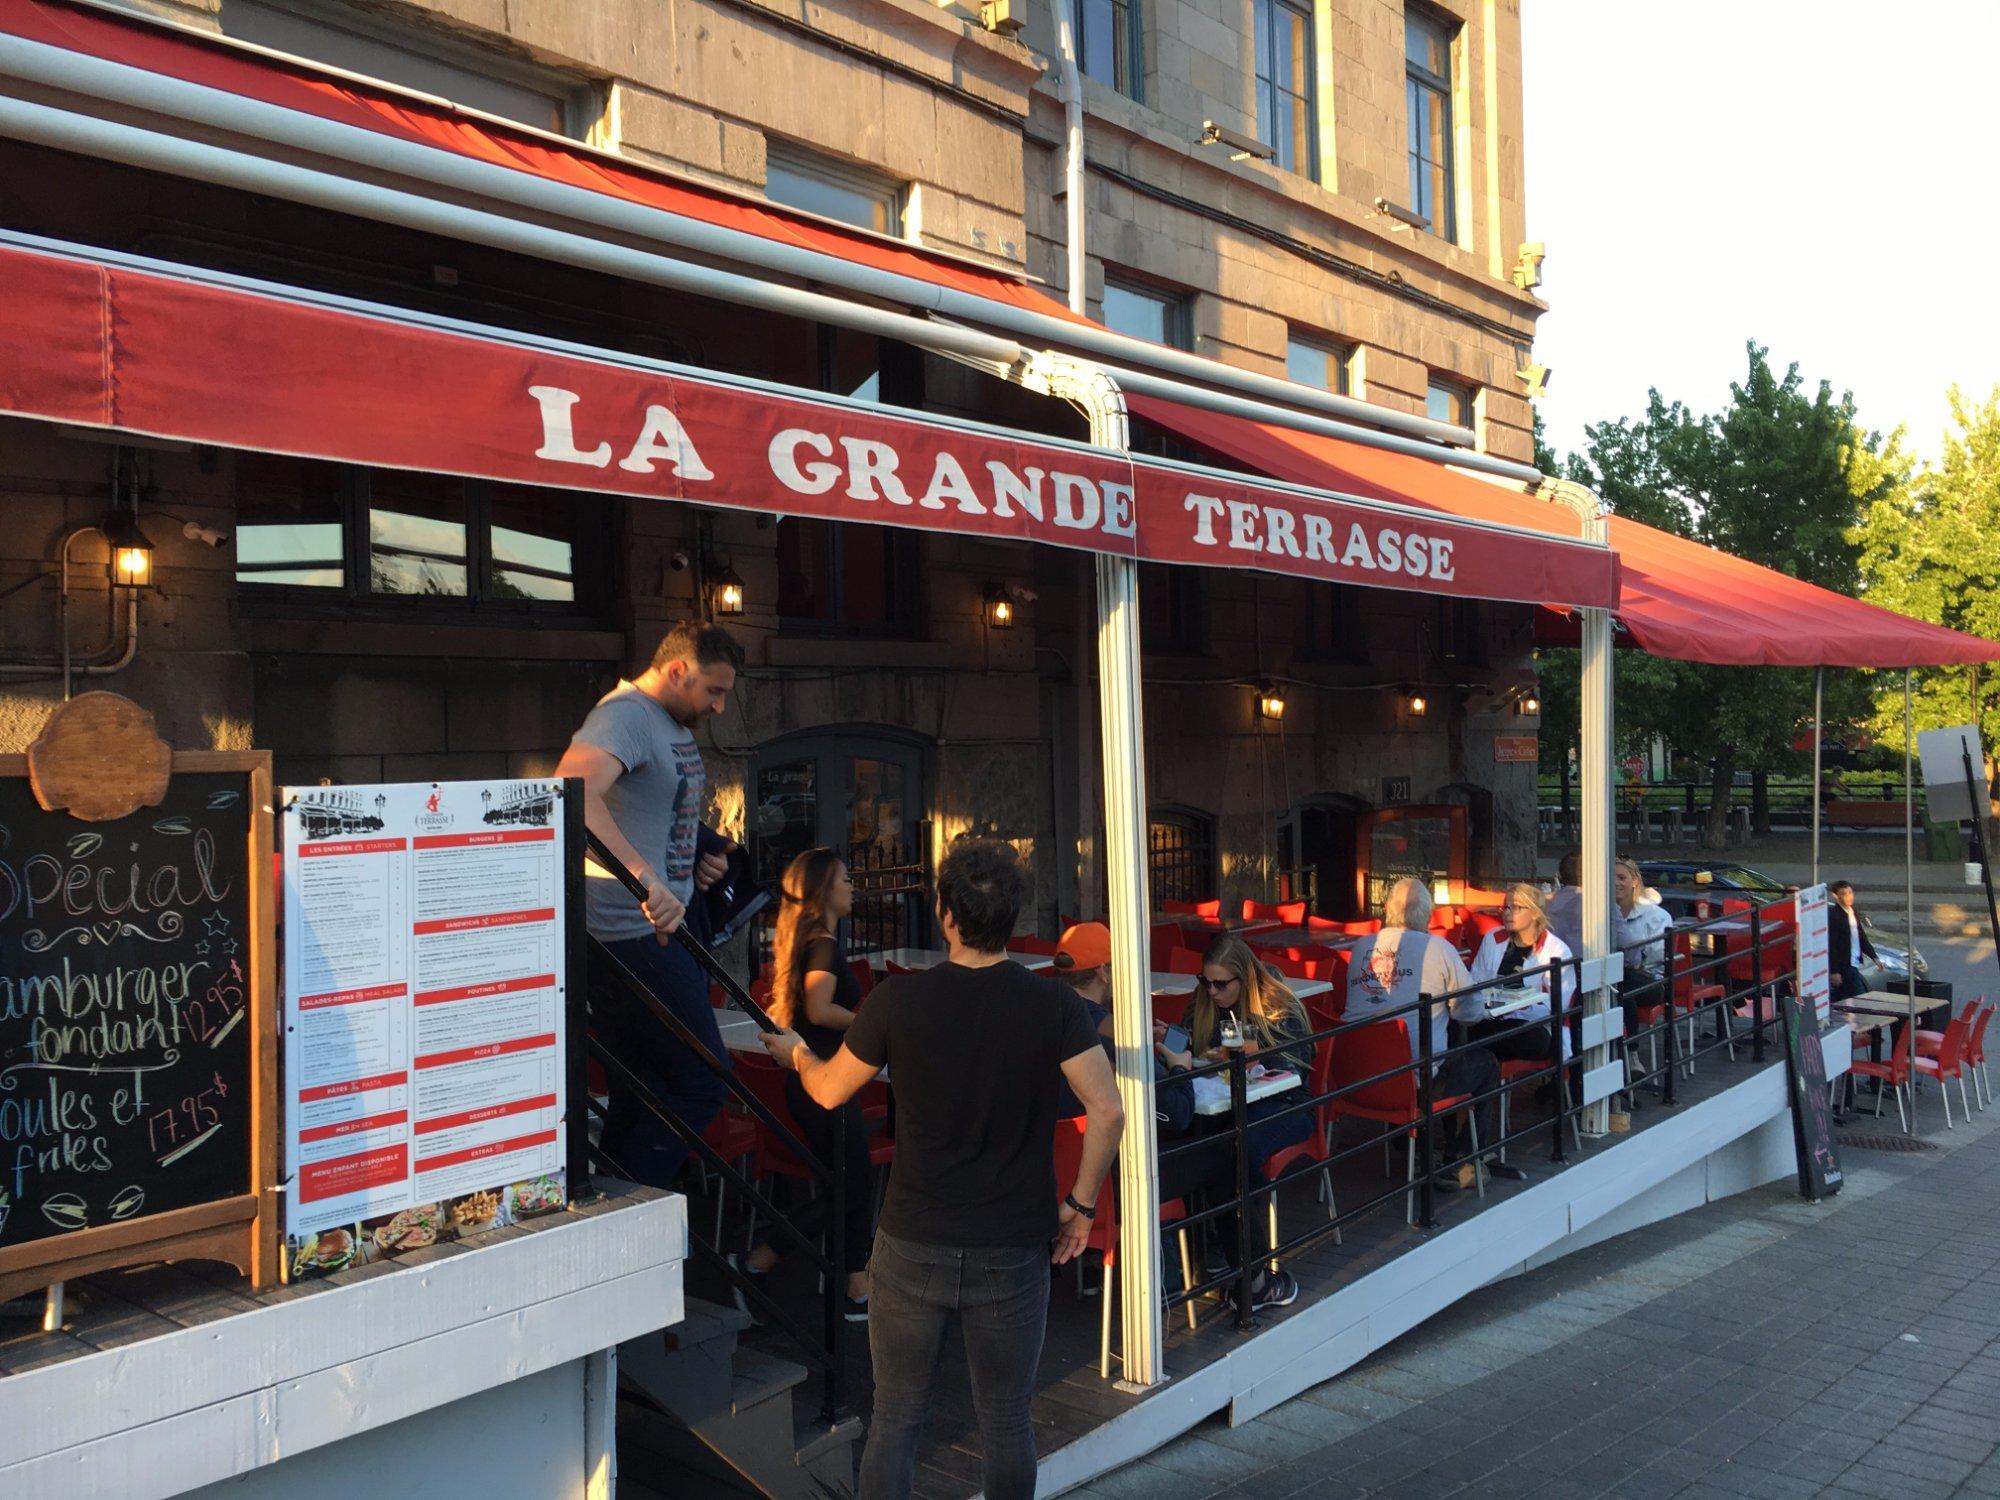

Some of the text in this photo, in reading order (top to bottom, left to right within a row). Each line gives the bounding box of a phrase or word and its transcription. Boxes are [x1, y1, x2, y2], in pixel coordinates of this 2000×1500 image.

[528, 385, 1455, 581] LA GRANDE TERRASSE
[469, 835, 495, 843] BURGERS
[467, 986, 495, 995] POUTINES
[24, 1003, 186, 1066] fondant
[474, 1048, 491, 1056] PIZZA
[361, 1080, 381, 1088] PASTA
[109, 1070, 150, 1125] et
[469, 1108, 498, 1120] DESSERTS
[471, 1147, 494, 1157] EXTRAS
[11, 1133, 113, 1199] frites
[312, 1153, 399, 1178] MENU ENFANT DISPONIBLE
